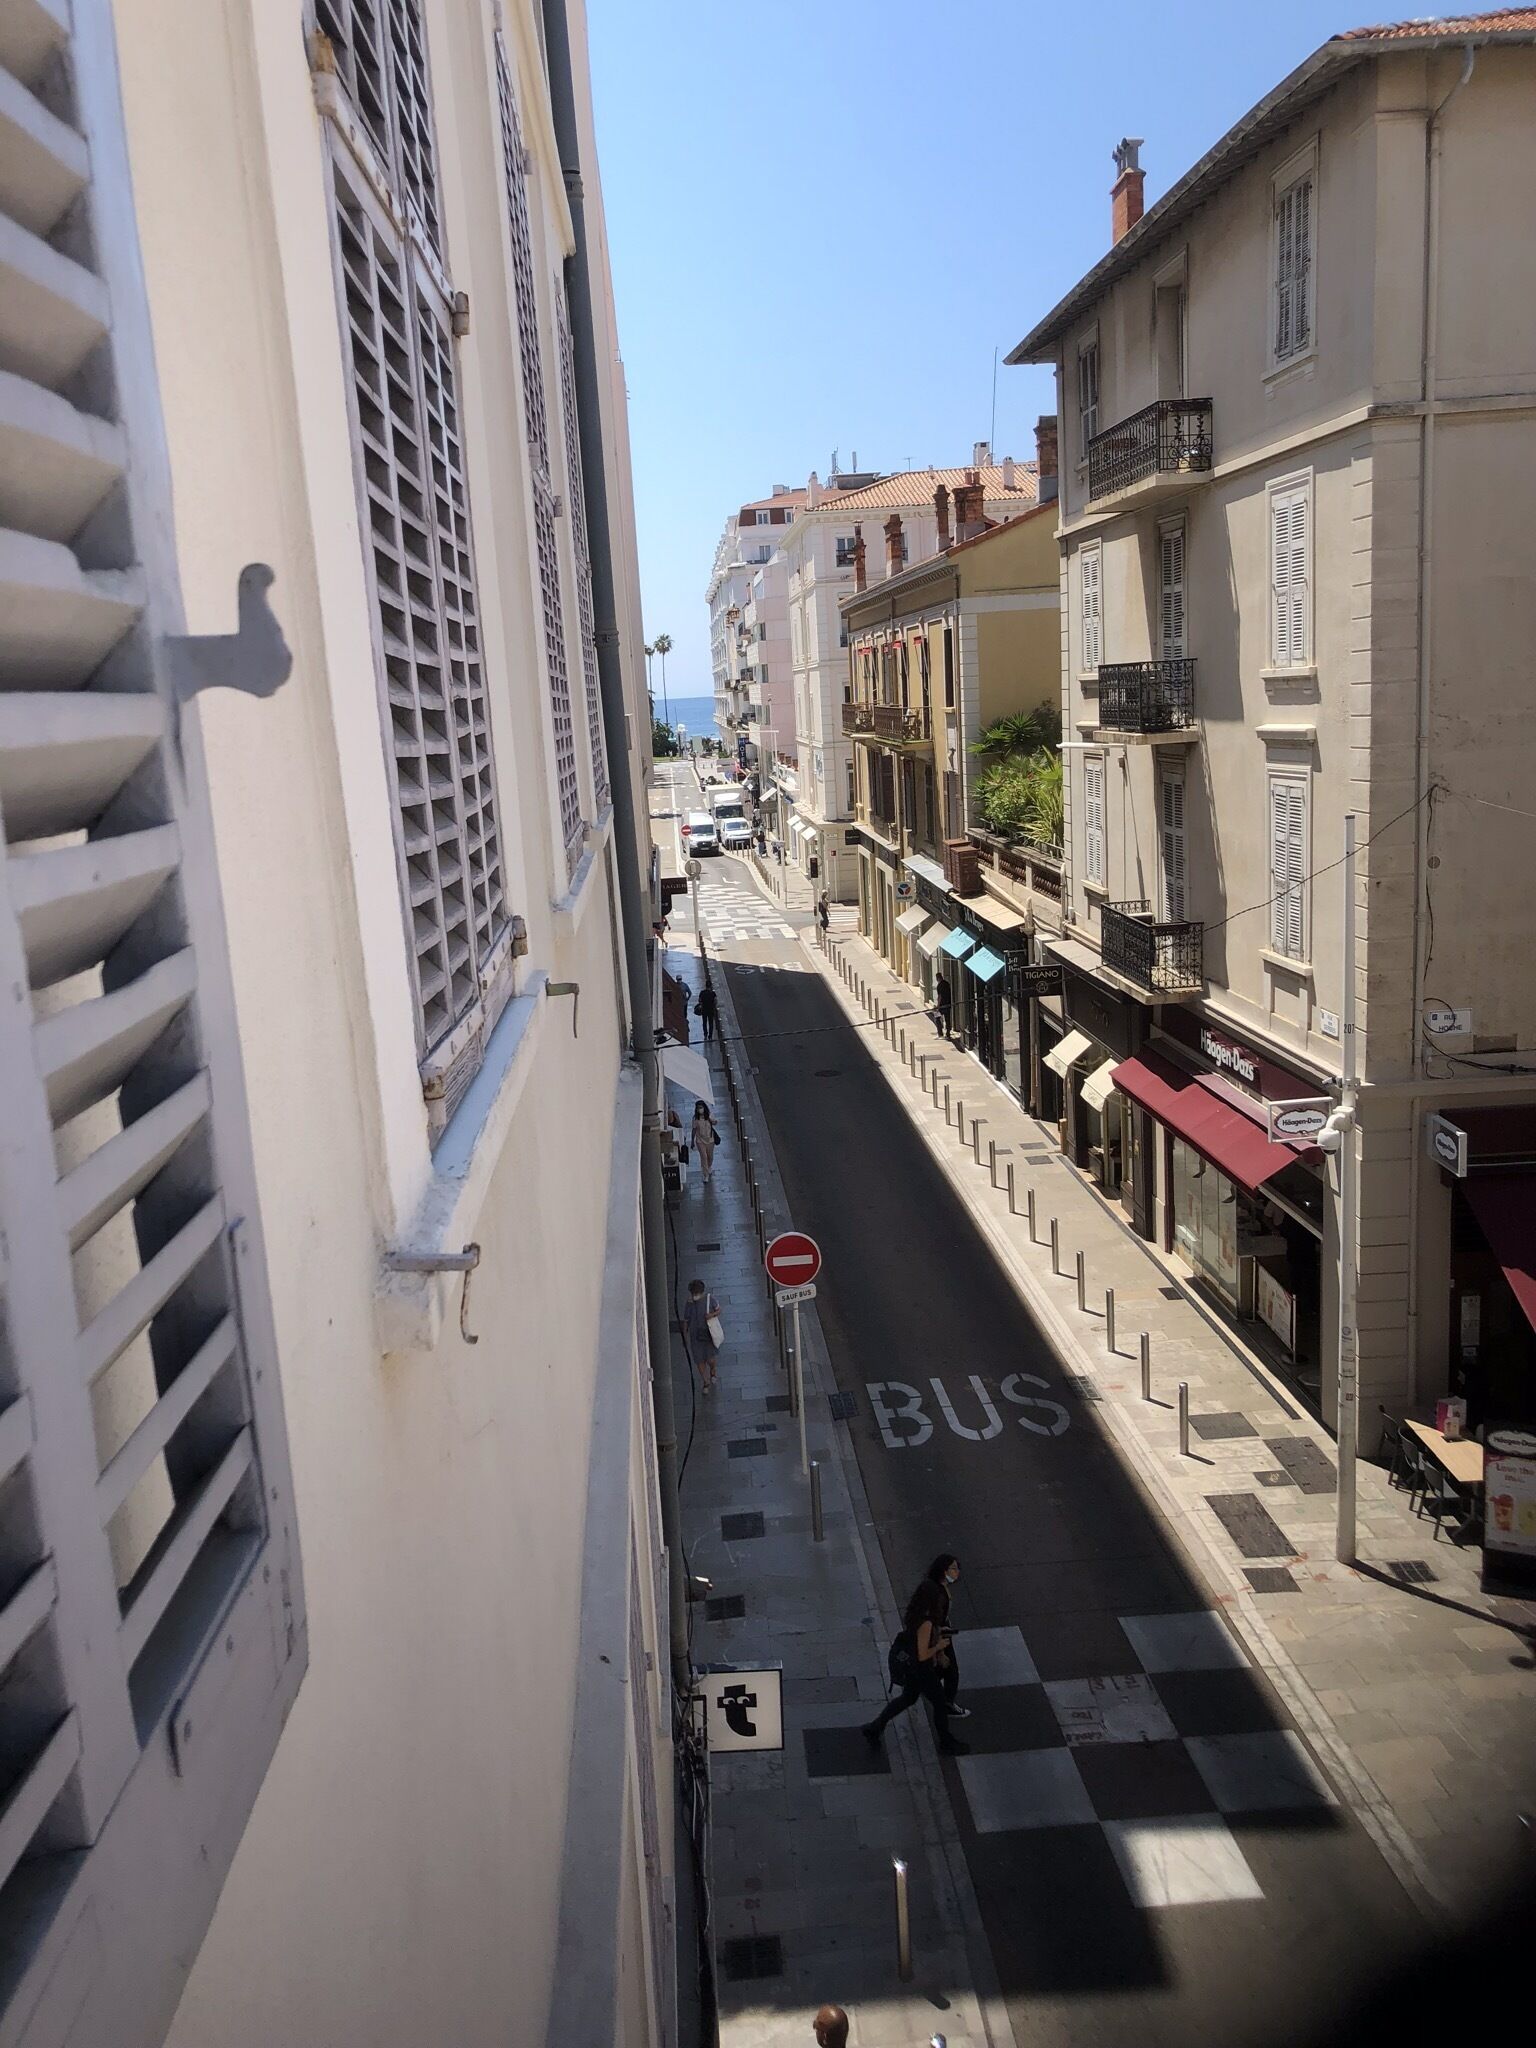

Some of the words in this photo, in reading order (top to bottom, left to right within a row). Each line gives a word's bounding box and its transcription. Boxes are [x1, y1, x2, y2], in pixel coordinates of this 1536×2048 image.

[738, 738, 746, 768] HOTEL
[1024, 969, 1059, 980] TIGIANO
[1344, 1023, 1355, 1034] 207
[1200, 1027, 1255, 1081] Häagen-Dazs
[1282, 1118, 1322, 1127] Häagen-Dazs
[781, 1293, 798, 1302] SAUF
[799, 1289, 812, 1298] BUS
[865, 1373, 1070, 1449] BUS
